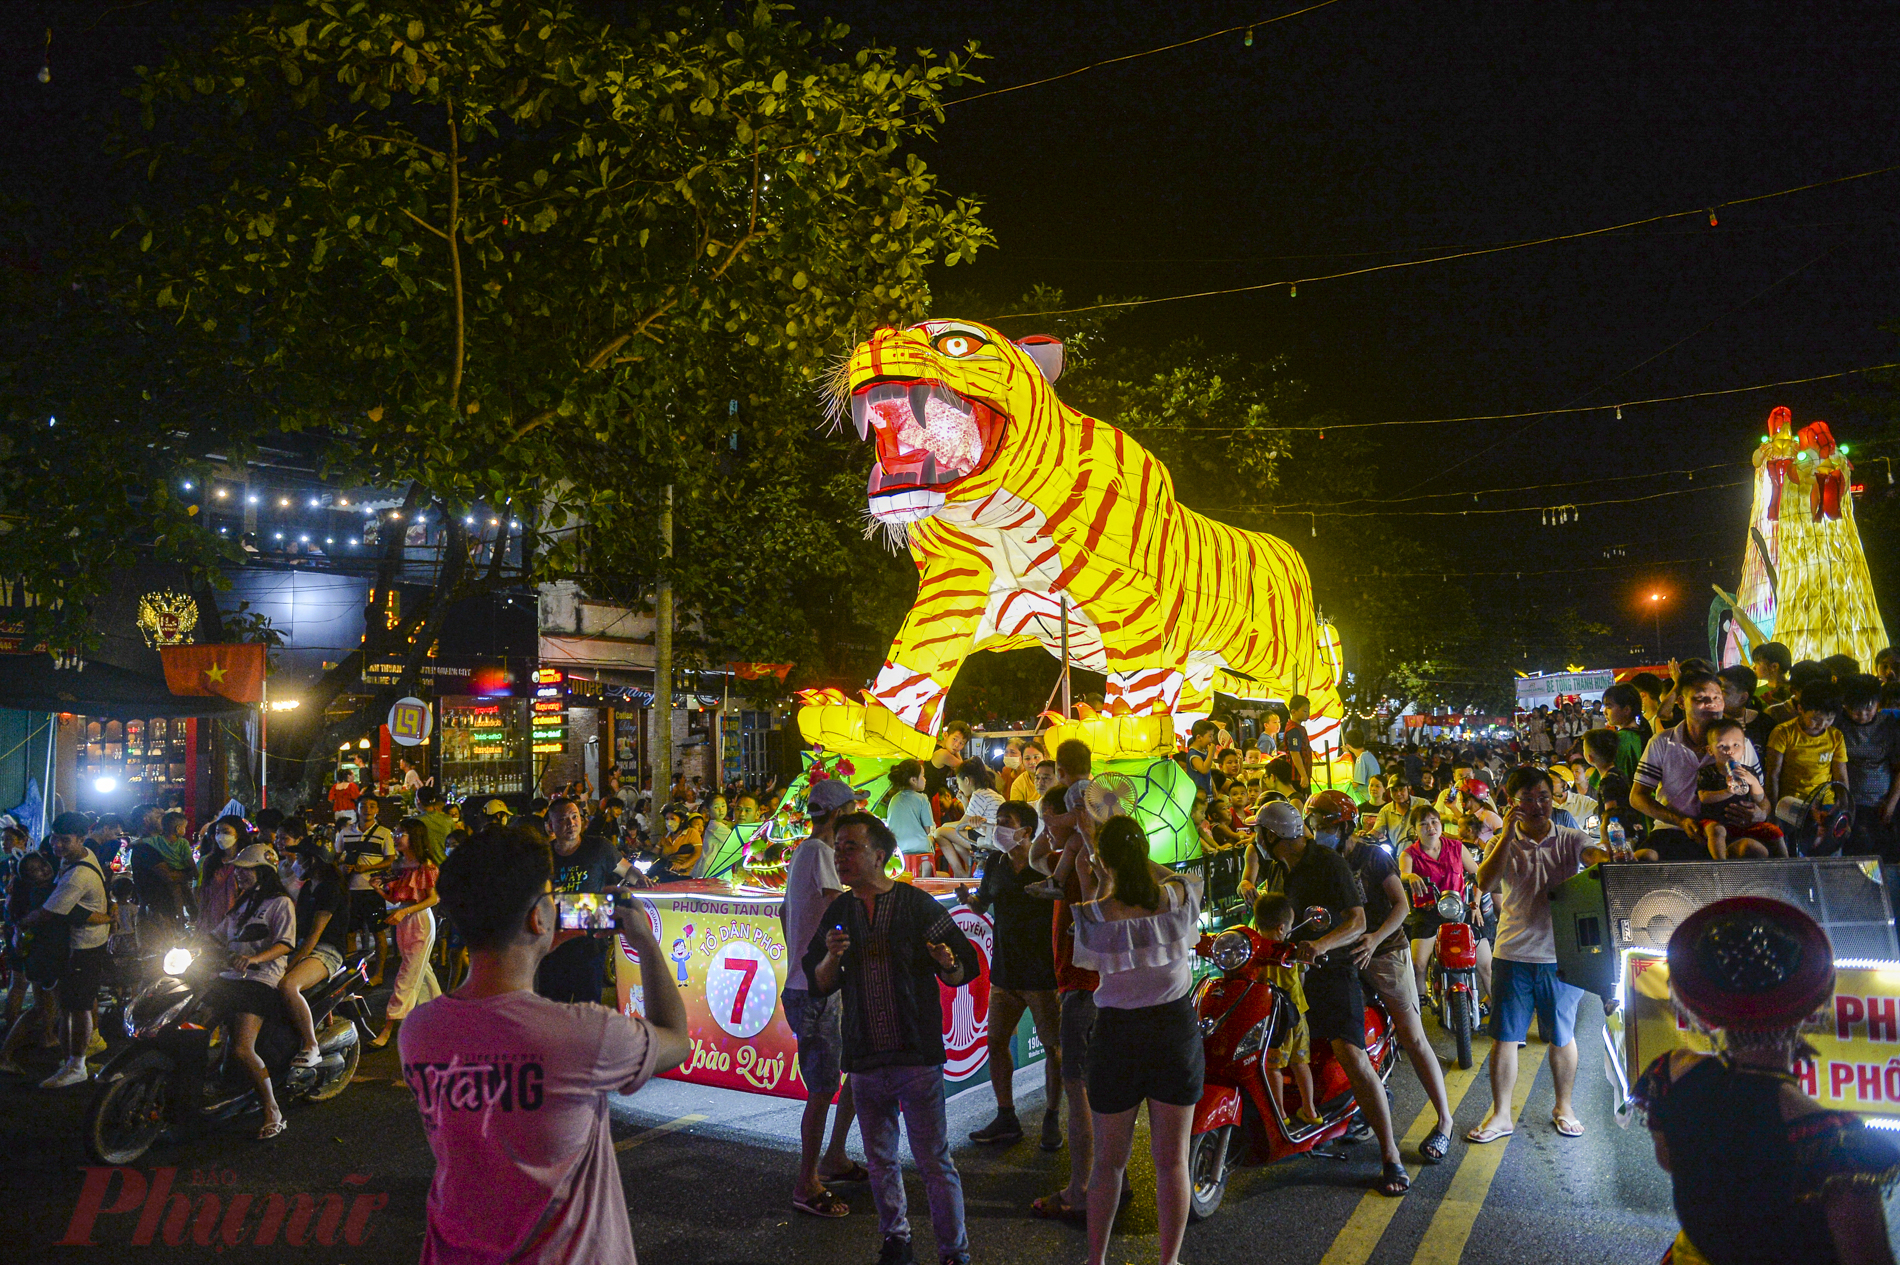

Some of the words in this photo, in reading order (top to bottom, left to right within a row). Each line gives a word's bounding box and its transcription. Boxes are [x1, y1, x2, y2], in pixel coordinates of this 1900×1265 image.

[700, 927, 717, 956] TỔ
[719, 920, 750, 942] DÂN
[753, 927, 785, 960] PHỐ
[724, 958, 758, 1025] 7
[1835, 995, 1900, 1042] PH
[736, 1045, 785, 1090] Quý
